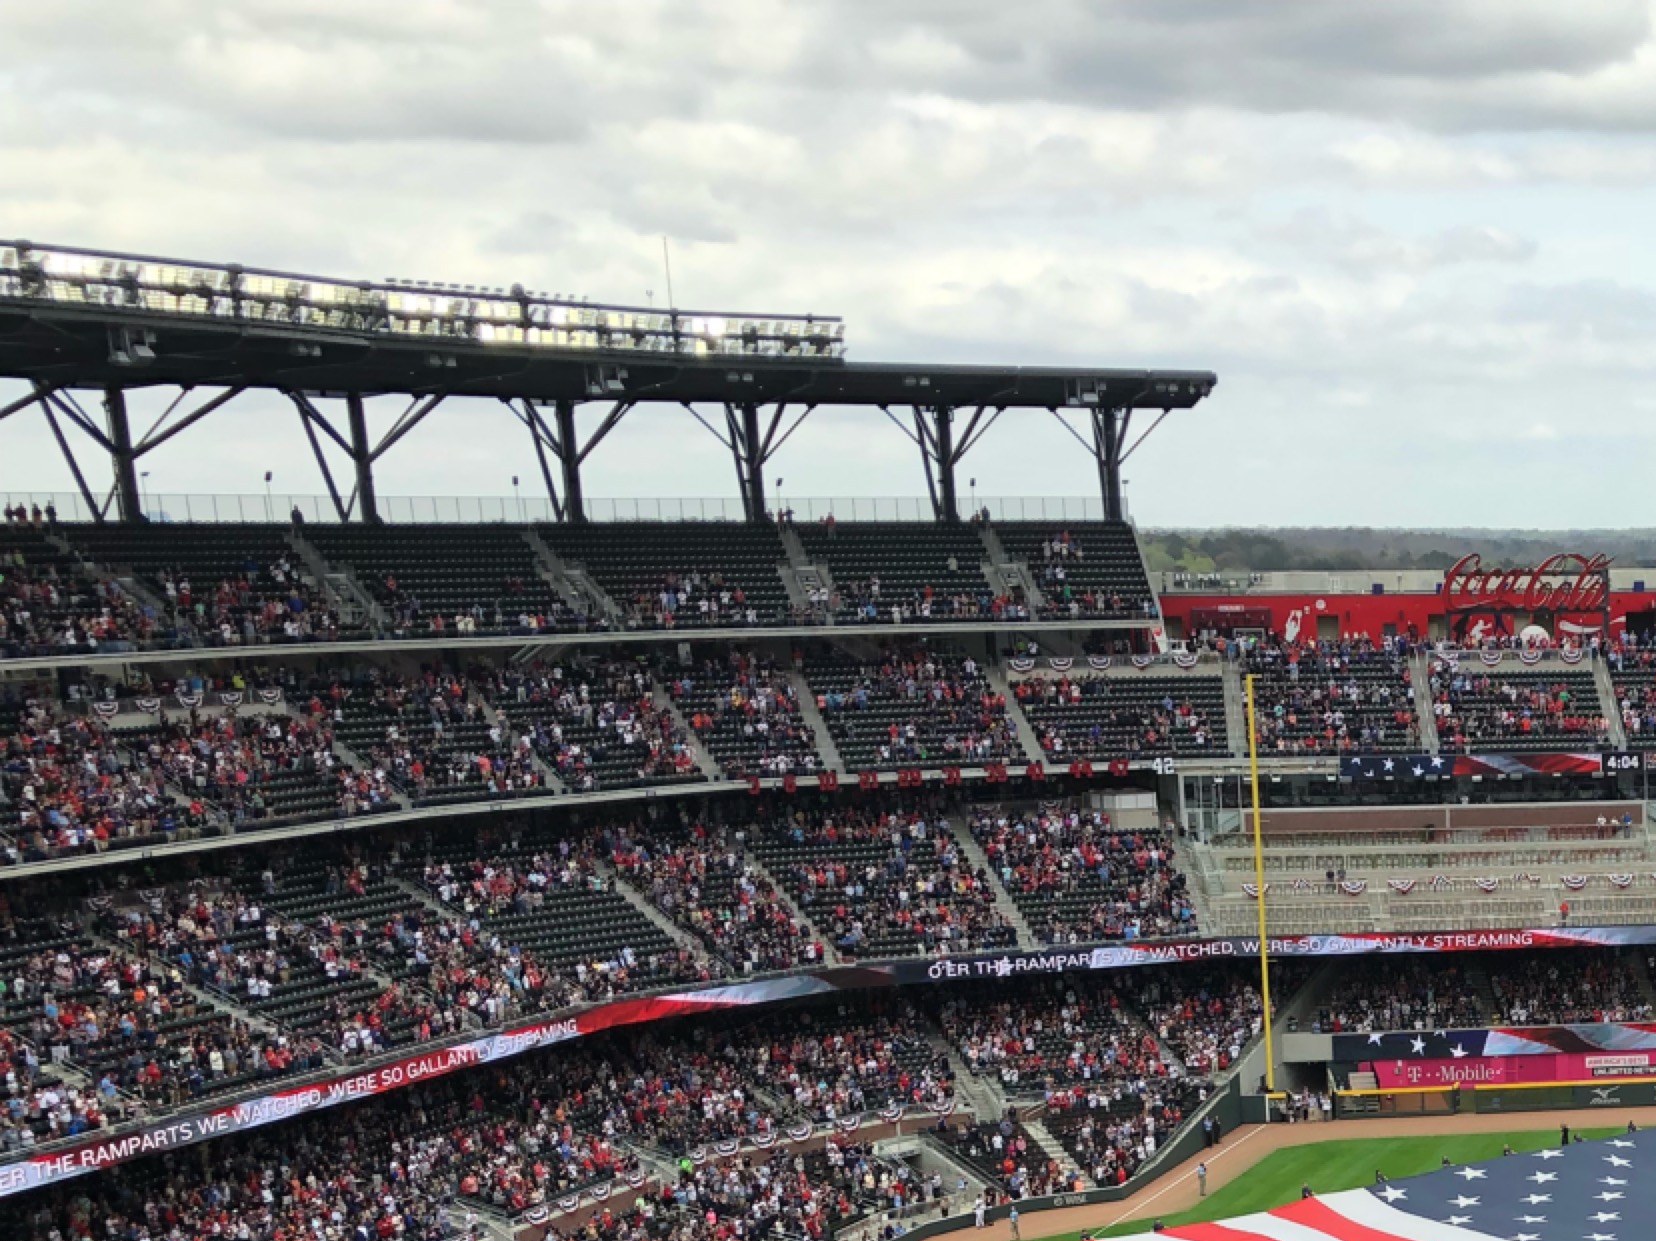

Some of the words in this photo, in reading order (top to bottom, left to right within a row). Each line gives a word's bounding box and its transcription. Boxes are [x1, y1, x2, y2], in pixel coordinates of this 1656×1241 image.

[1153, 757, 1175, 774] 42
[1607, 755, 1639, 769] 4:04
[1118, 950, 1145, 961] WE
[1150, 941, 1237, 960] WATCHED,
[1299, 937, 1321, 951] SO
[1329, 935, 1428, 951] GALLANTLY
[1433, 931, 1533, 949] STREAMING
[31, 1153, 76, 1179] THE
[81, 1122, 193, 1167] RAMPARTS
[196, 1111, 229, 1135] WE
[232, 1089, 325, 1125] WATCHED,
[328, 1073, 378, 1099] WERE
[381, 1066, 403, 1086] SO
[406, 1047, 494, 1079] GALLANTLY
[498, 1017, 578, 1055] STREAMING
